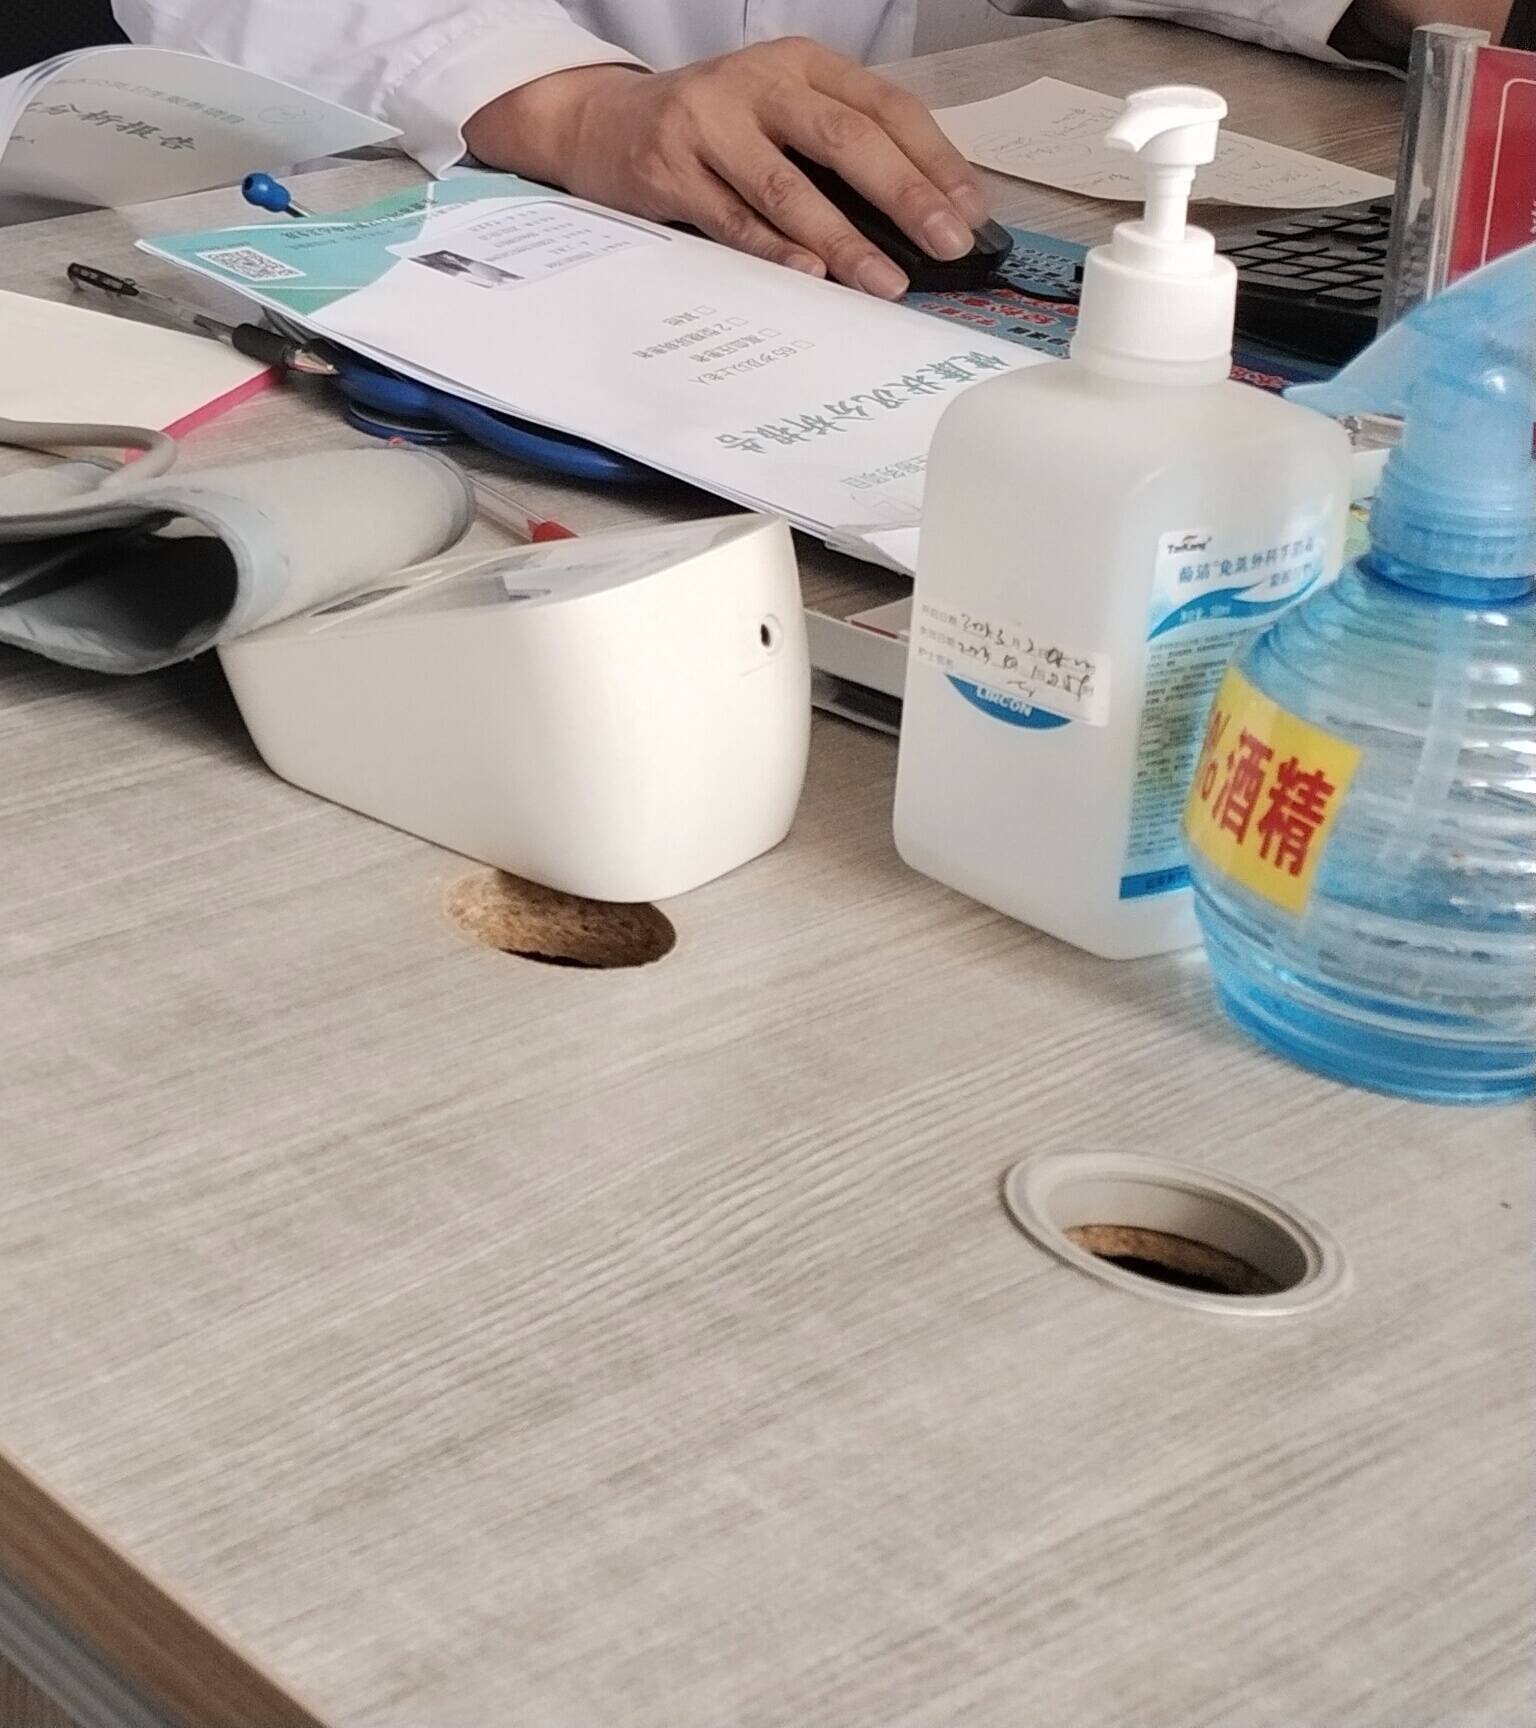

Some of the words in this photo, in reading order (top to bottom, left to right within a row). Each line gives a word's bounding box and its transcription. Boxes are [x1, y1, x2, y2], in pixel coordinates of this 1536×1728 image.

[715, 350, 1012, 454] 健康状况分析报告
